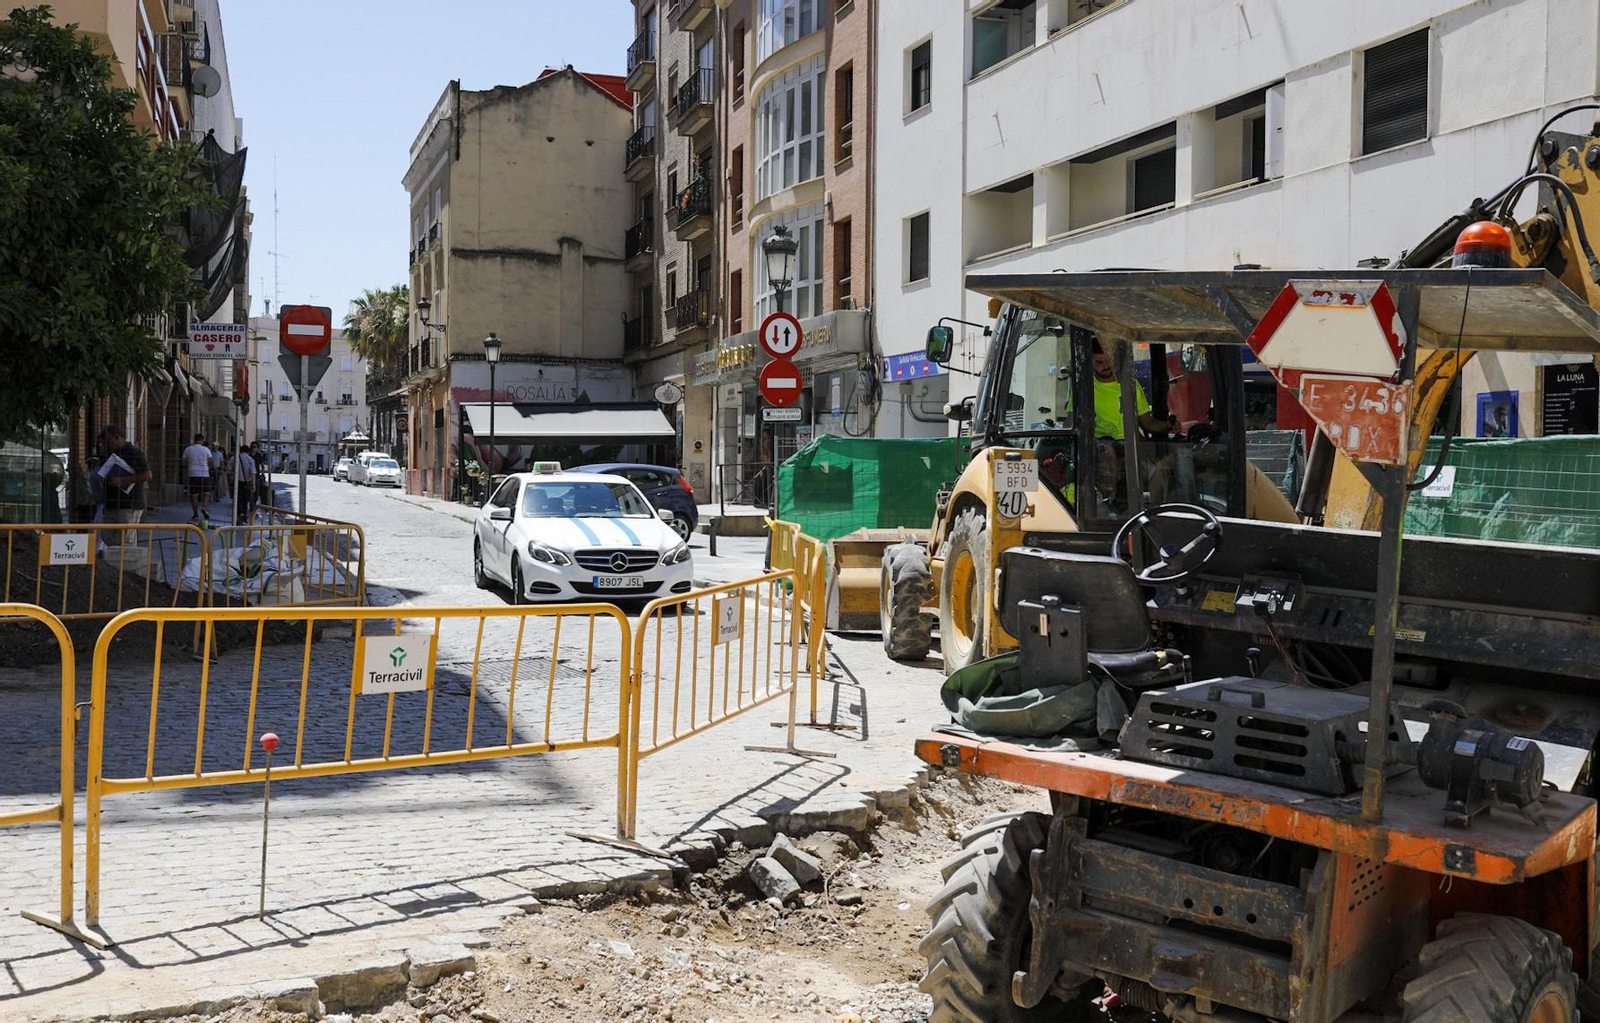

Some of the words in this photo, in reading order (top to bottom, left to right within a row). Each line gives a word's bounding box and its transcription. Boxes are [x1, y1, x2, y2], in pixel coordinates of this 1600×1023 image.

[194, 333, 242, 343] CASERO
[1557, 374, 1566, 382] LA
[1566, 373, 1584, 381] LUNA
[506, 382, 567, 401] ROSALÍA
[996, 462, 1003, 474] E
[1007, 462, 1033, 474] 5934
[1006, 476, 1028, 488] BFD
[1425, 484, 1451, 492] erracivil
[1000, 491, 1022, 515] 40
[53, 551, 86, 560] Terracivil
[599, 577, 623, 587] 8907
[626, 577, 642, 587] JSL
[368, 667, 423, 684] Terracivil
